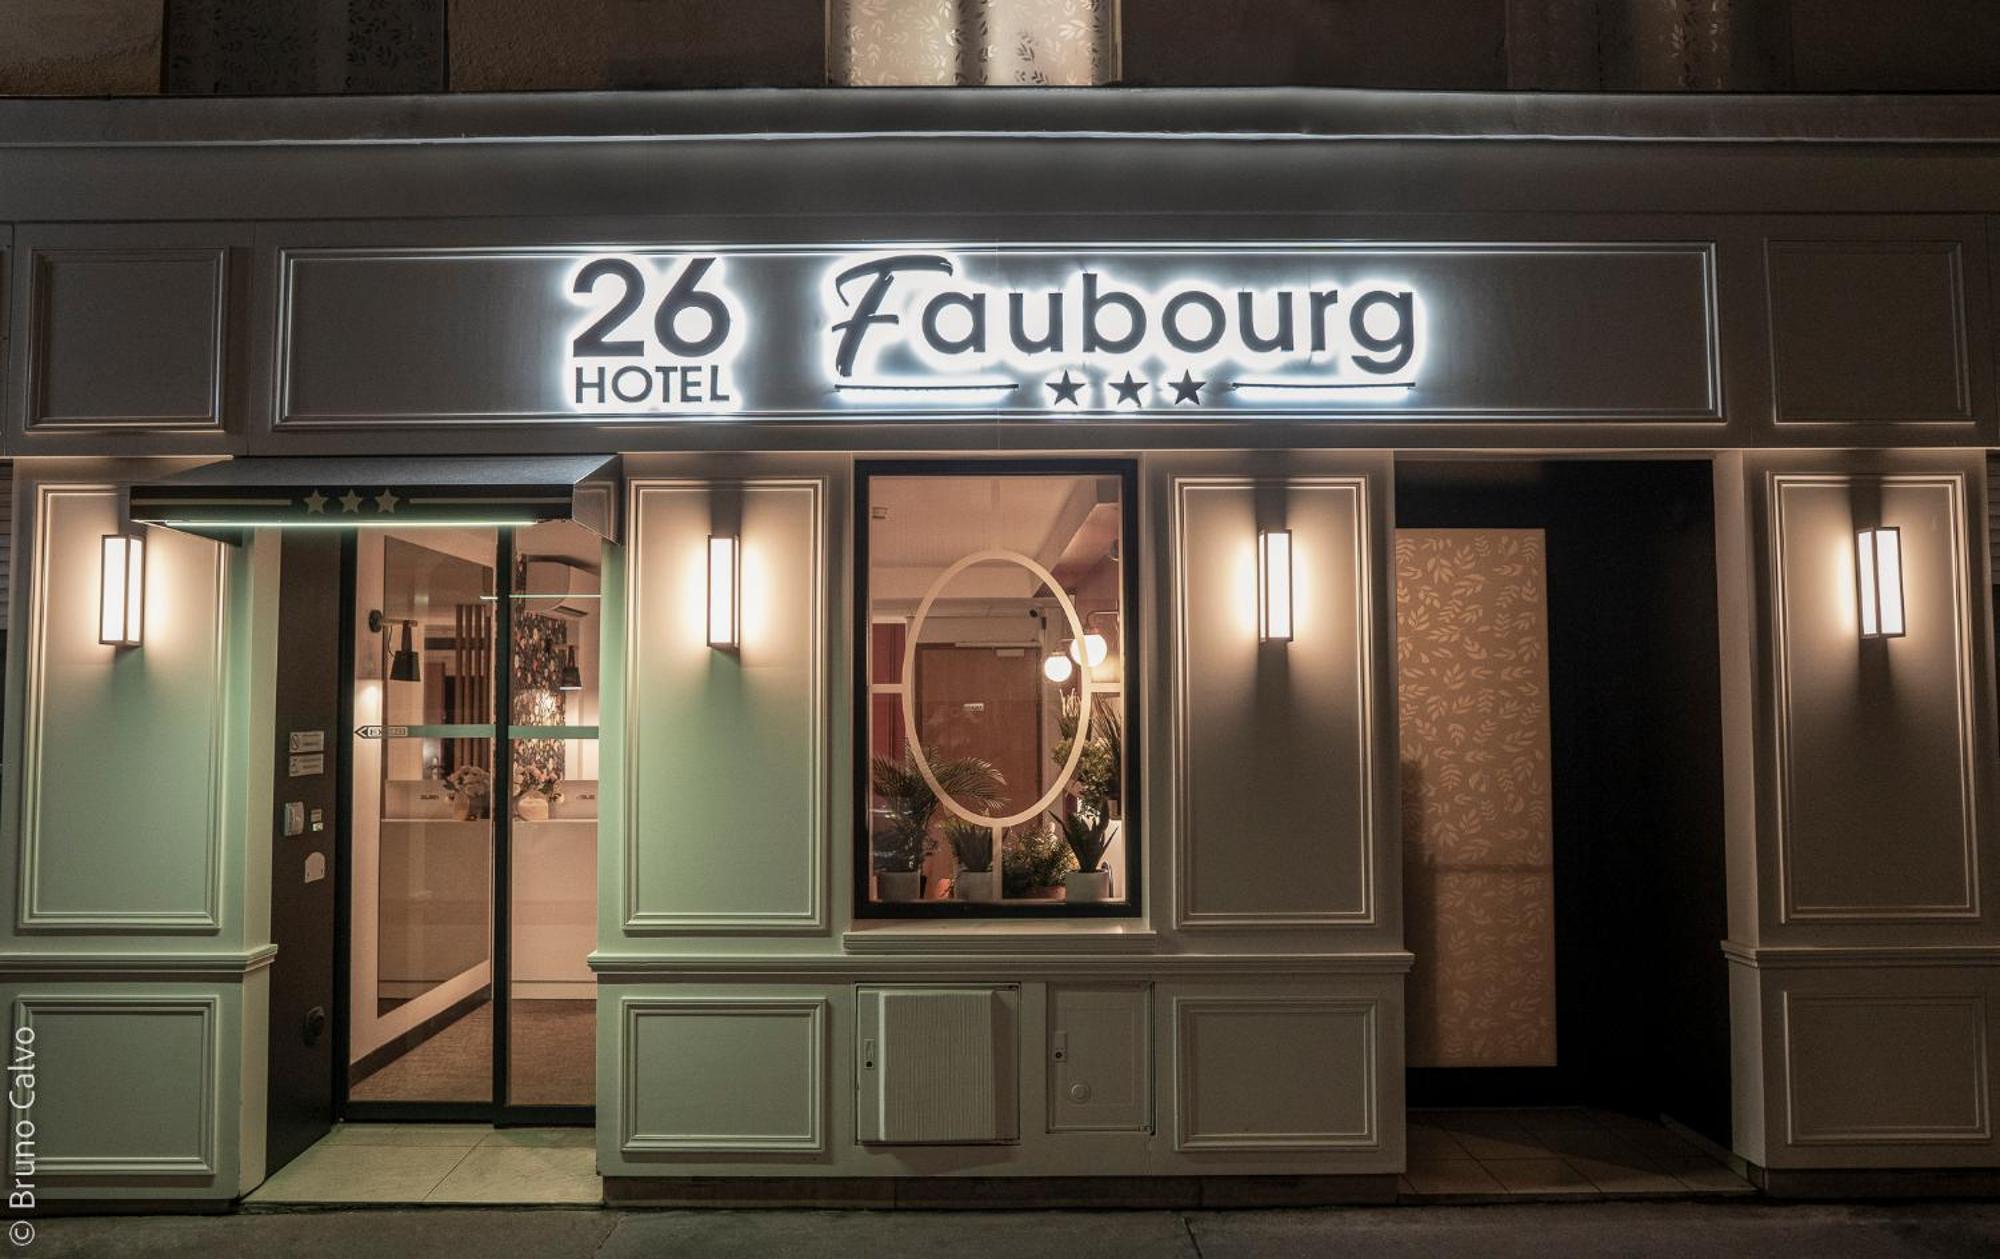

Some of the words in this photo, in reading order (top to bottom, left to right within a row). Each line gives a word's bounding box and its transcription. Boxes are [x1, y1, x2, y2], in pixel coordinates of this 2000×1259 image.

[573, 257, 731, 357] 26
[831, 254, 1415, 377] Faubourg
[575, 365, 730, 403] HOTEL
